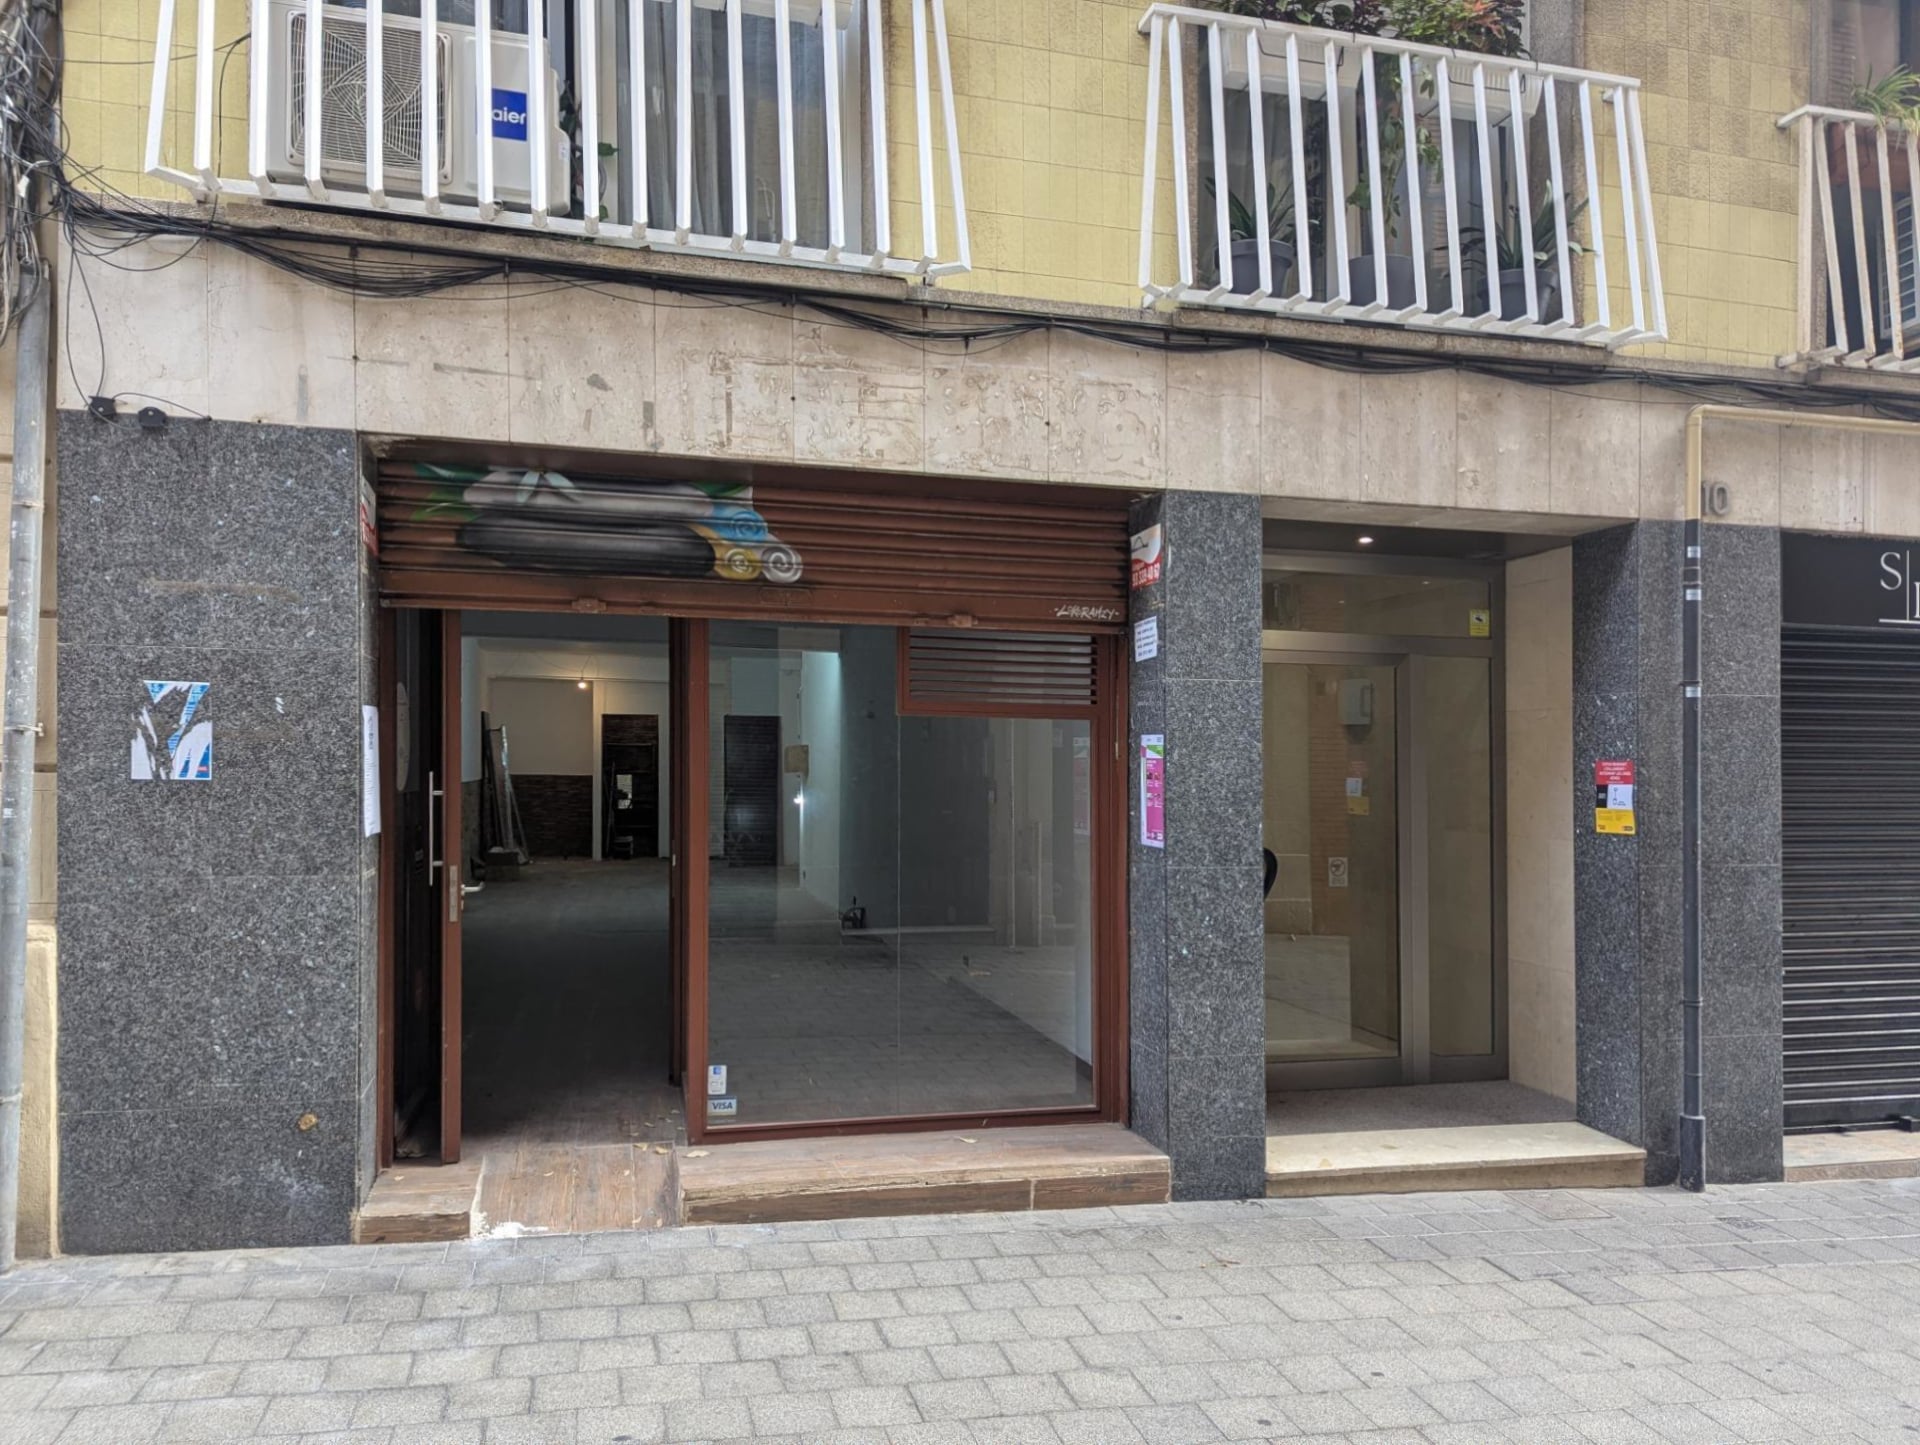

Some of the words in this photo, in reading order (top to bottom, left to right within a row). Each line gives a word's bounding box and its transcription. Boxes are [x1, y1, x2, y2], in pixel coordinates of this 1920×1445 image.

[492, 106, 527, 125] aier
[1702, 481, 1730, 516] 10
[712, 1102, 733, 1111] VISA
